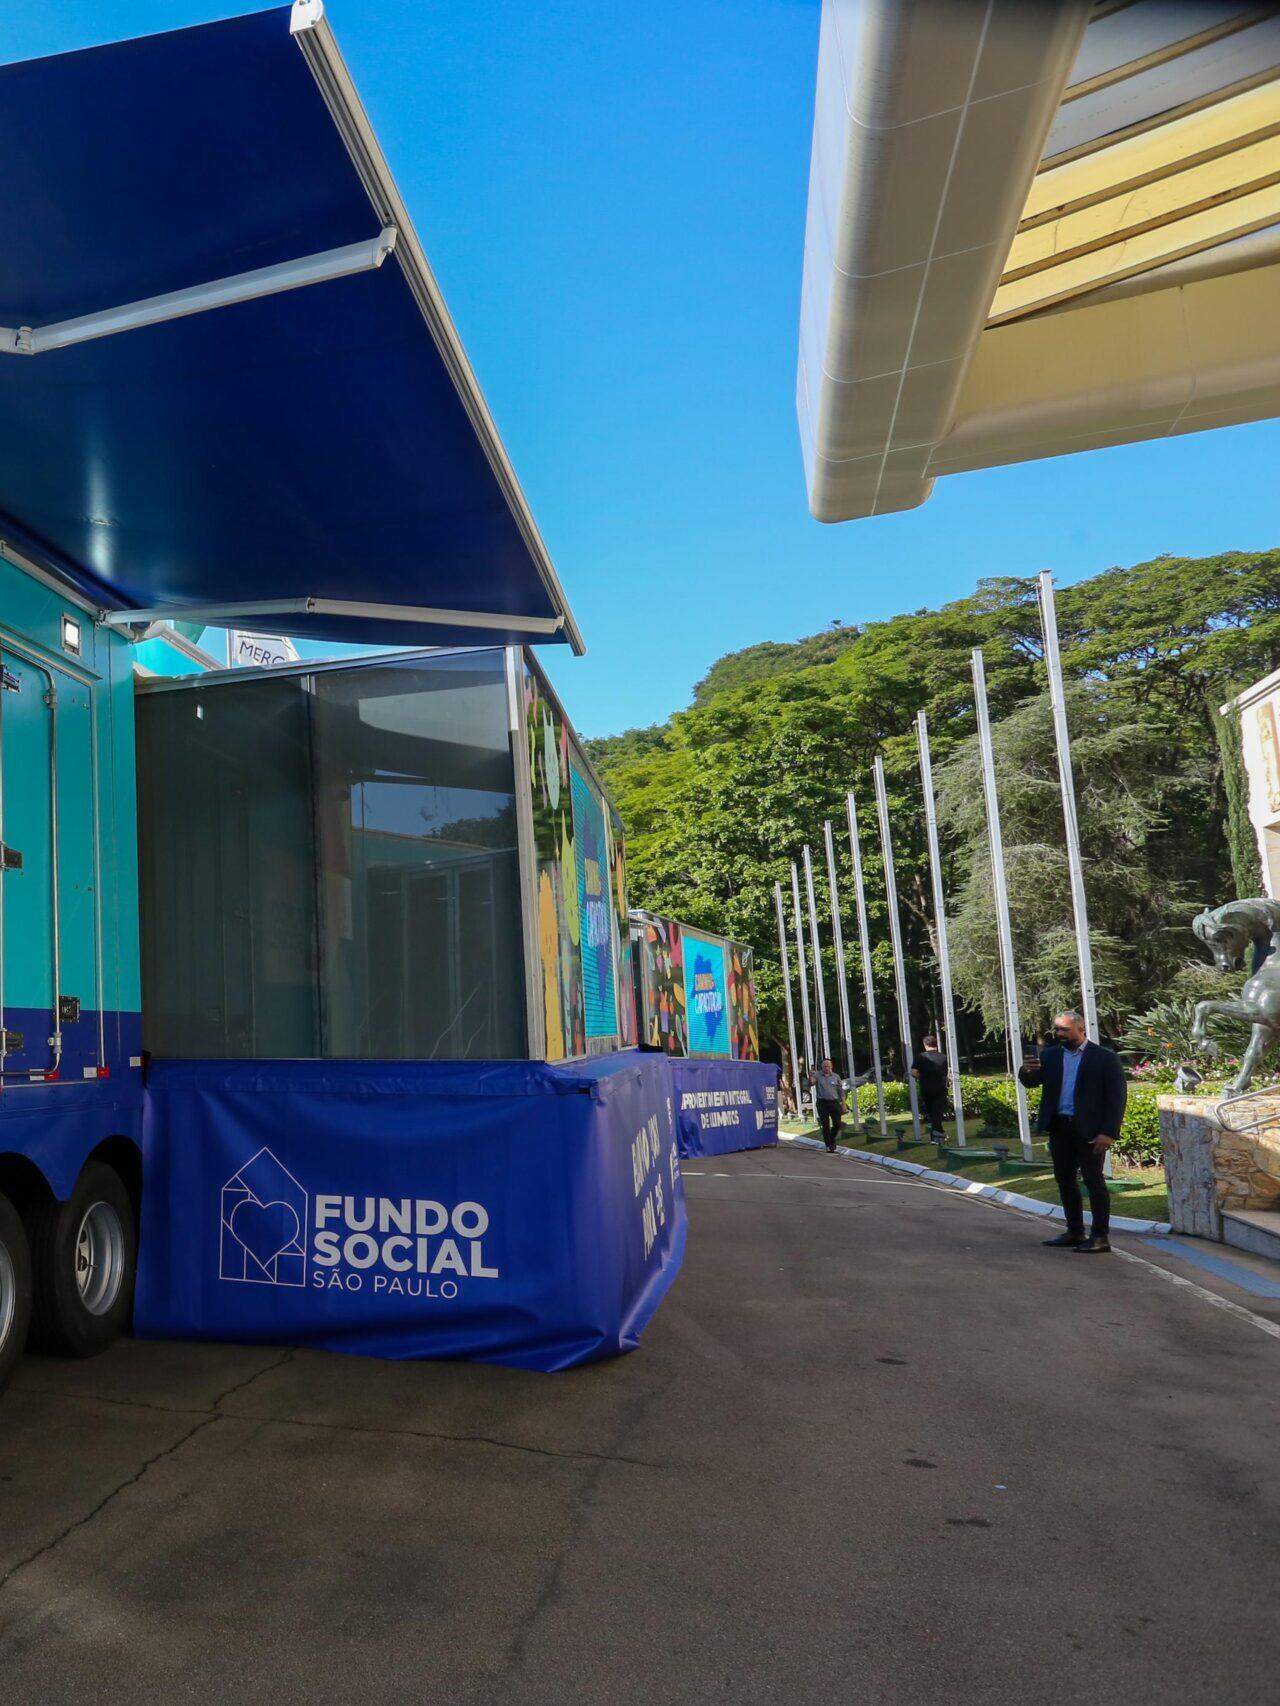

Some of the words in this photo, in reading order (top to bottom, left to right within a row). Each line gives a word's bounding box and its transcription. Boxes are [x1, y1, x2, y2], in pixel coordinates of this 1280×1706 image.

[315, 1194, 489, 1238] FUNDO
[312, 1231, 499, 1278] SOCIAL
[313, 1268, 362, 1291] SÃO
[374, 1275, 458, 1299] PAULO
